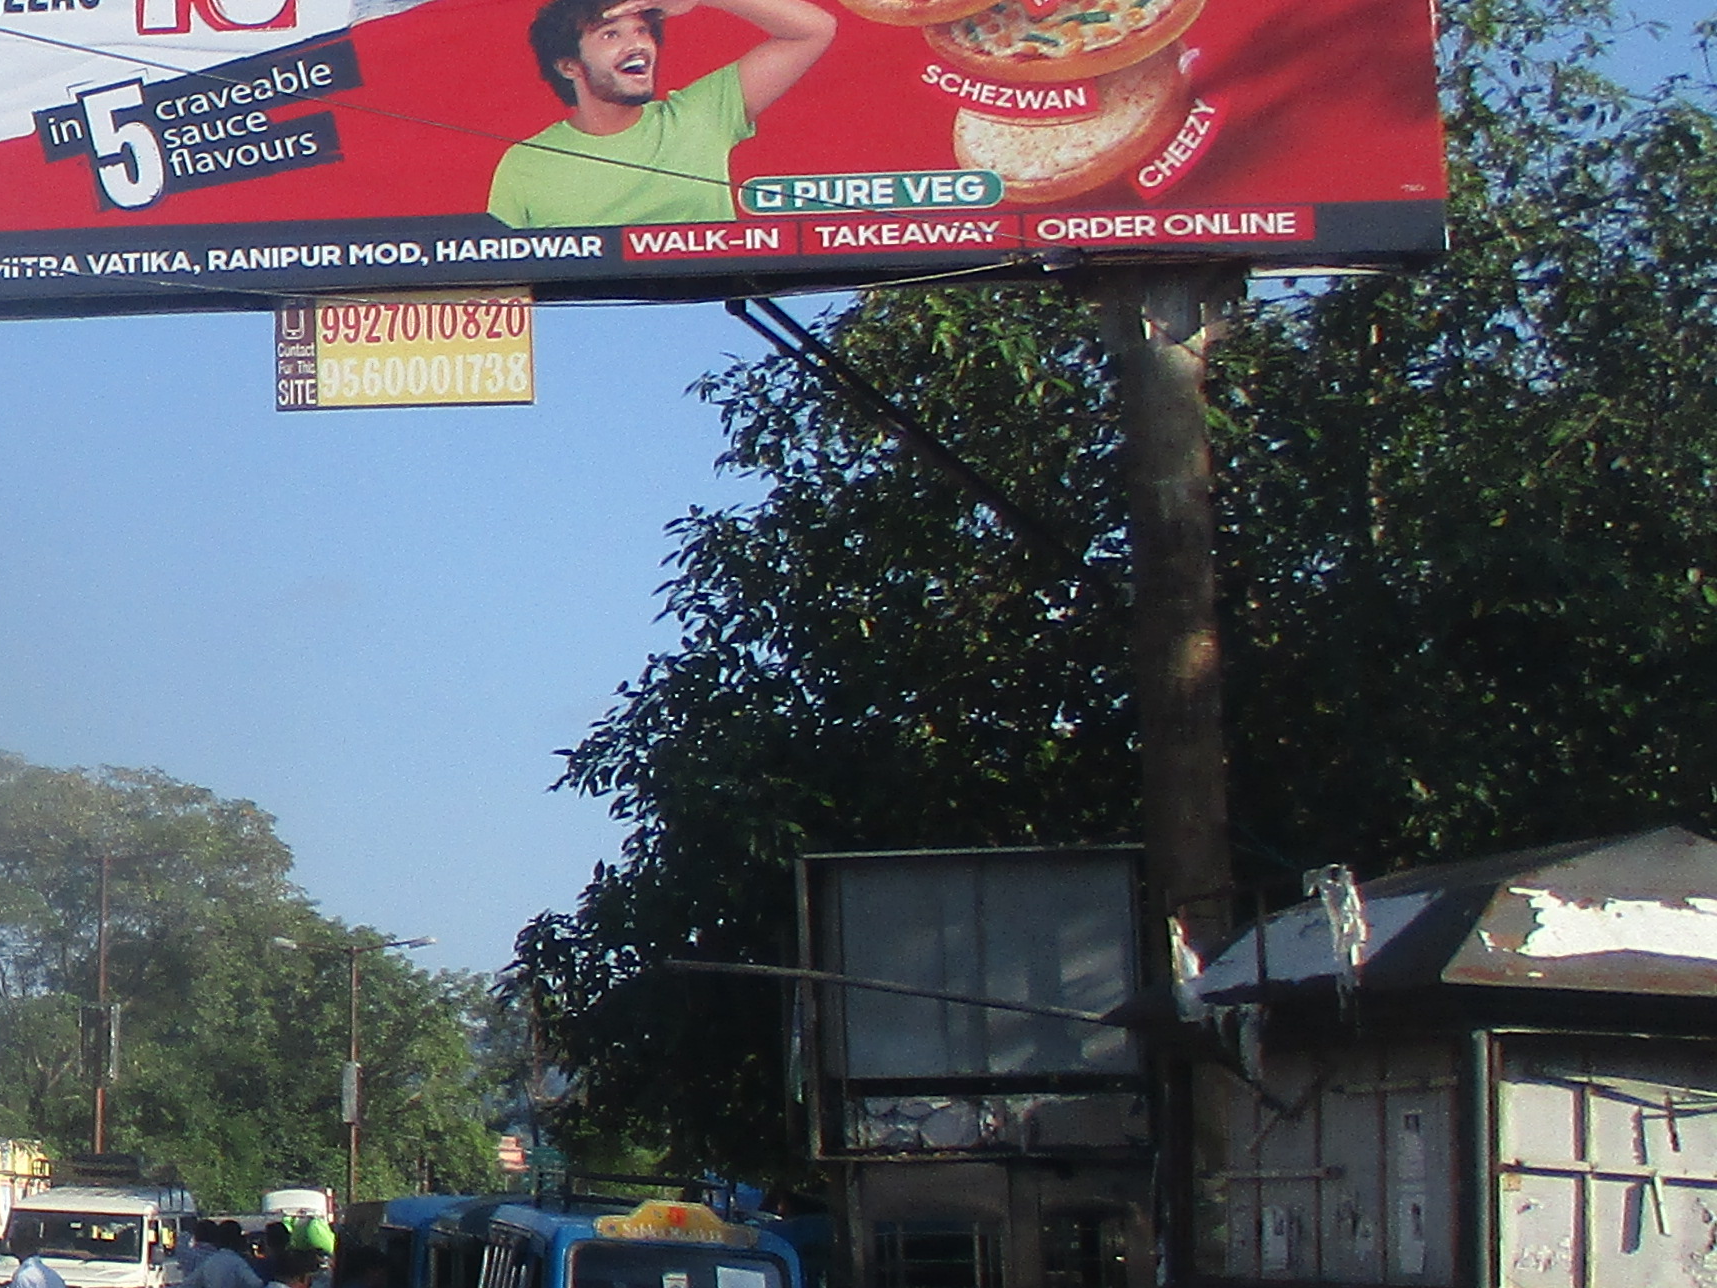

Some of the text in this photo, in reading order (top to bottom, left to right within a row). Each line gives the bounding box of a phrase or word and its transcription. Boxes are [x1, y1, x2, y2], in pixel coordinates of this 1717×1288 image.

[154, 59, 334, 121] craveable
[920, 64, 1087, 111] SCHEZWAN
[47, 82, 164, 209] in 5
[163, 109, 268, 150] sauce
[169, 127, 317, 178] flavours
[1137, 97, 1217, 193] CHEEZY
[793, 175, 986, 208] PURE VEG
[85, 250, 202, 276] VATIKA,
[208, 246, 341, 272] RANIPUR
[348, 241, 429, 270] MOD,
[436, 236, 603, 263] HARIDWAR
[629, 226, 779, 254] WALK-IN
[815, 220, 1000, 248] TAKEAWAY
[1037, 214, 1157, 241] ORDER
[1163, 211, 1296, 237] ONLINE
[321, 298, 526, 344] 9927010820
[277, 342, 315, 359] Contact
[277, 379, 316, 405] SITE
[321, 353, 528, 399] 9560001738
